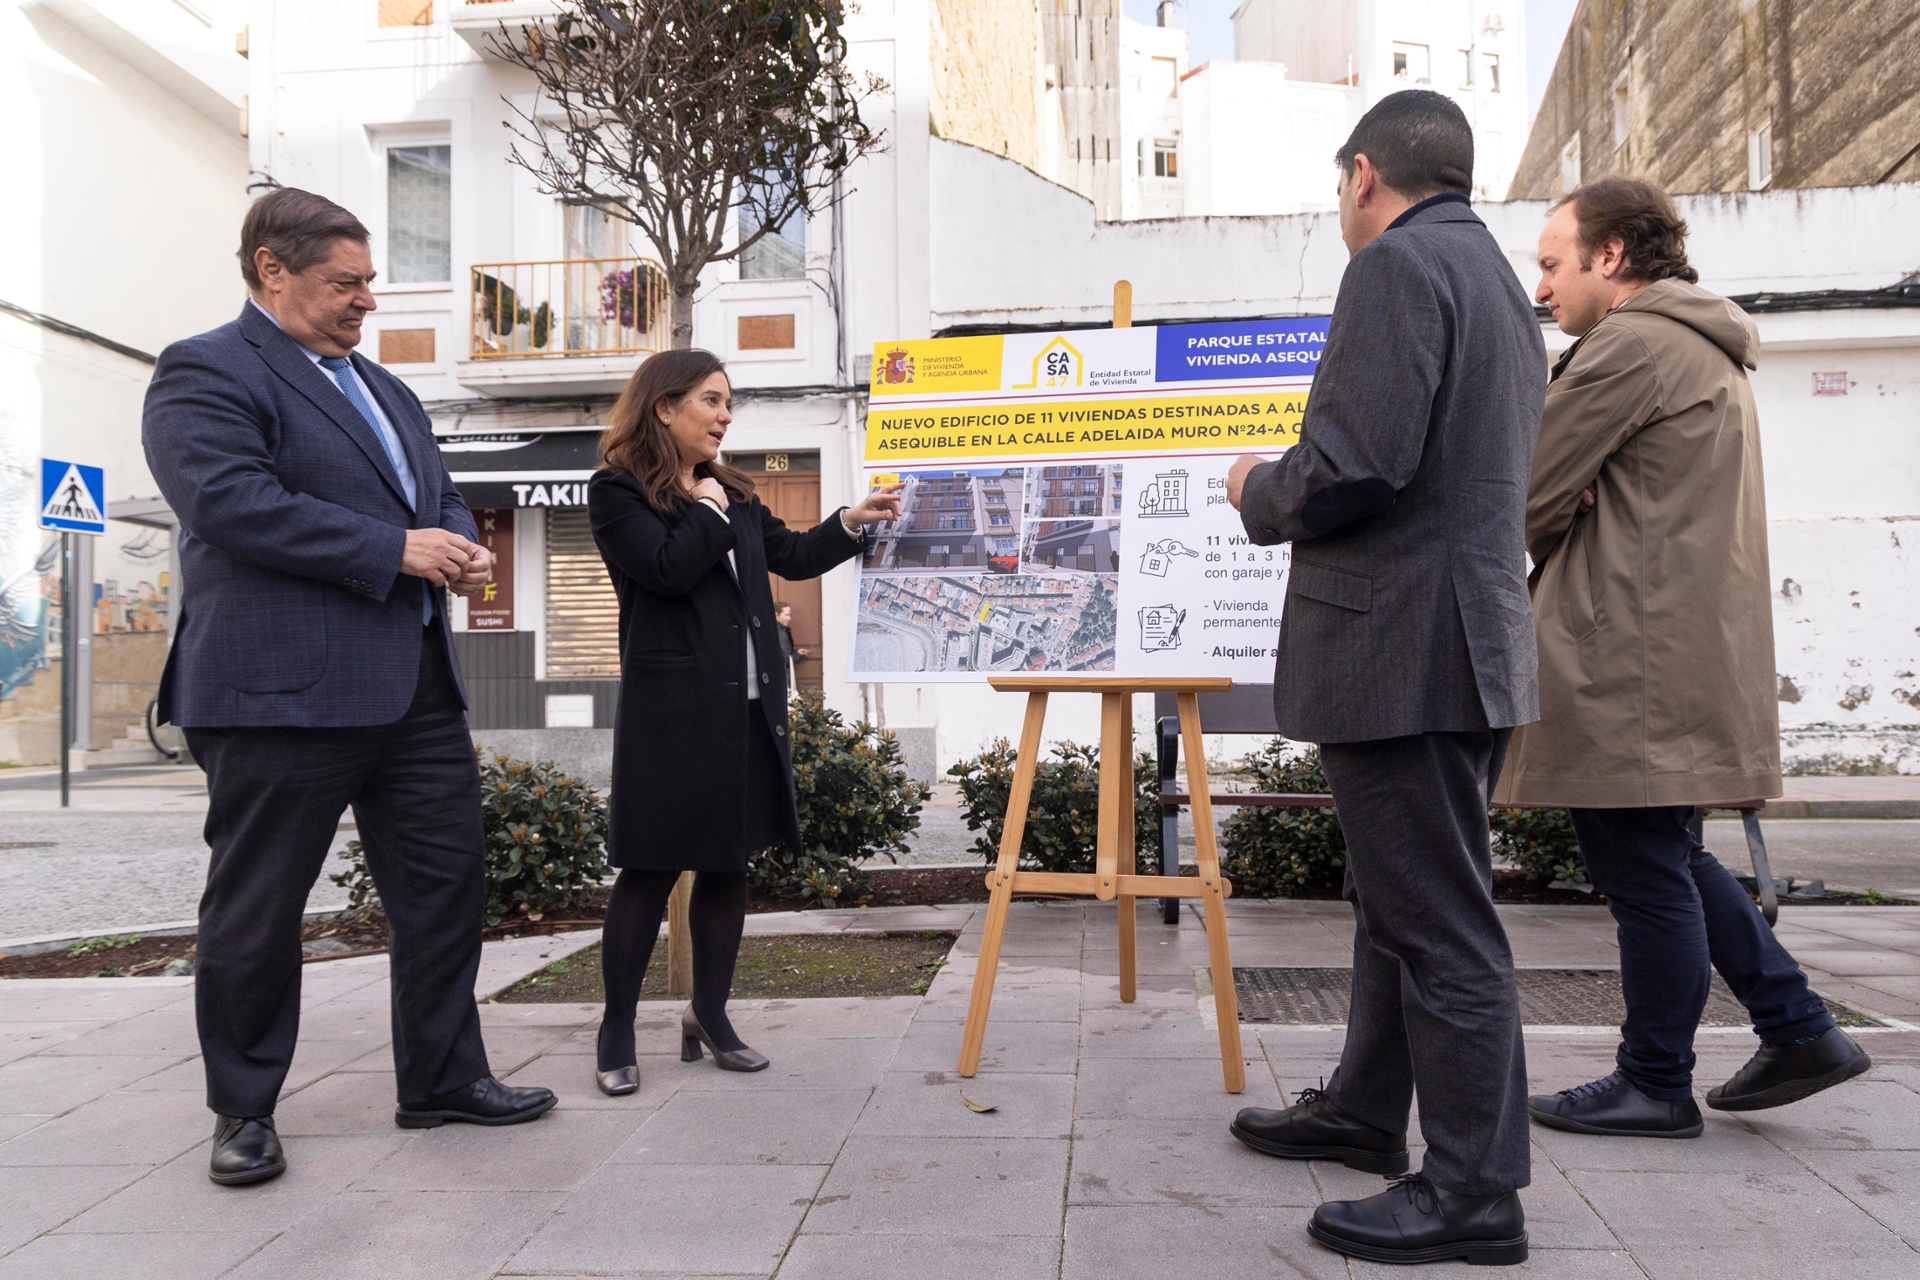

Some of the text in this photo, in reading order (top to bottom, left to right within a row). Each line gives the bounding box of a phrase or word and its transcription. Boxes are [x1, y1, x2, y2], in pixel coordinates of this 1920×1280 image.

[1188, 332, 1327, 348] PARQUE ESTATAL
[1046, 352, 1070, 364] CA
[1186, 353, 1262, 366] VIVIENDA
[1046, 364, 1069, 376] SA
[1090, 368, 1152, 378] Entidad Estatal
[1046, 376, 1068, 388] 47
[1090, 378, 1100, 386] de
[881, 418, 935, 430] NUEVO
[940, 414, 1010, 428] EDIFICIO
[1014, 412, 1036, 425] DE
[1040, 412, 1053, 424] 11
[1058, 408, 1147, 422] VIVIENDAS
[1152, 402, 1260, 418] DESTINADAS
[1266, 402, 1278, 414] A
[878, 436, 966, 450] ASEQUIBLE
[971, 434, 992, 446] EN
[996, 433, 1018, 446] LA
[1023, 431, 1075, 444] CALLE
[1080, 428, 1166, 442] ADELAIDA
[1171, 425, 1222, 438] MURO
[768, 455, 786, 470] 26
[1206, 535, 1220, 546] 11
[1205, 551, 1221, 562] de
[1231, 551, 1237, 562] 1
[1248, 552, 1256, 562] a
[1265, 550, 1273, 562] 3
[1204, 566, 1284, 581] con garaje y
[1213, 600, 1269, 612] Vivienda
[476, 618, 504, 626] SUSHI
[1204, 616, 1282, 630] permanente
[1212, 646, 1267, 660] Alquiler
